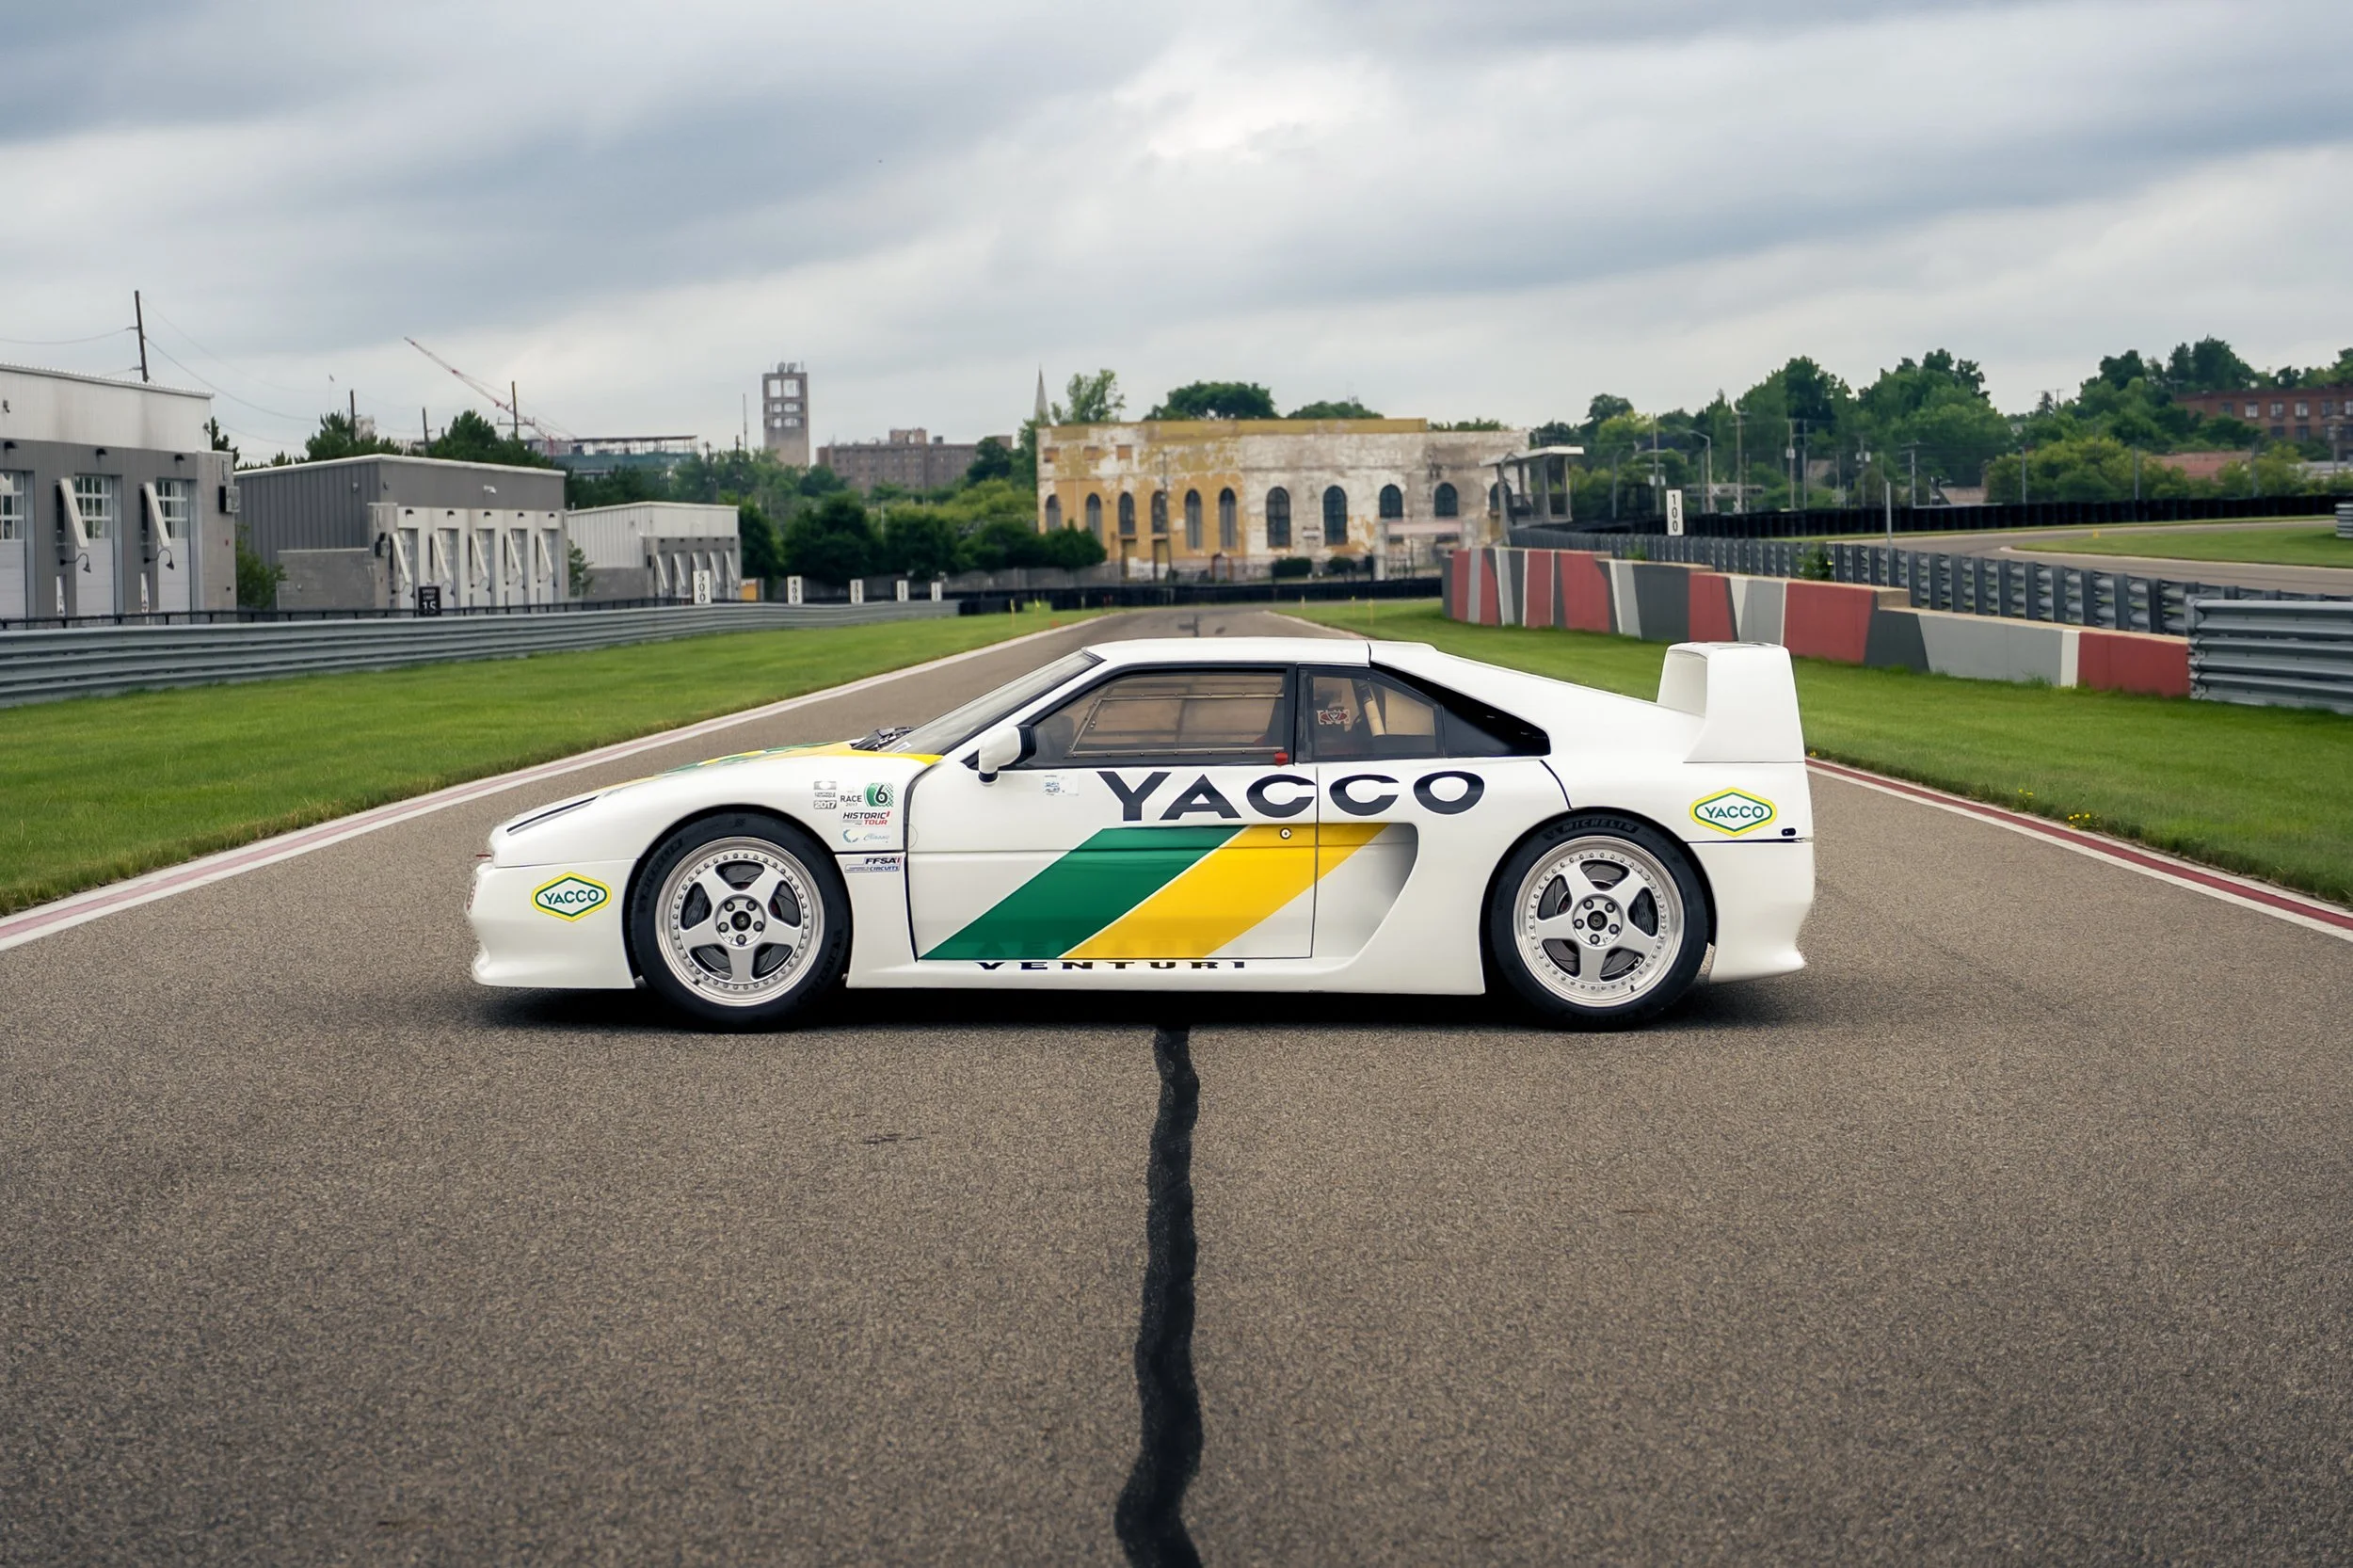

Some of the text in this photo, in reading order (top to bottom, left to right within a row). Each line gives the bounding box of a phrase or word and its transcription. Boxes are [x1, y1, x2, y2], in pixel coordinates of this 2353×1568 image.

[875, 784, 888, 804] 6
[1096, 770, 1485, 822] YACCO
[1705, 805, 1764, 819] YACCO
[1562, 818, 1635, 833] MICHELIN
[544, 888, 599, 904] YACCO
[974, 961, 1245, 970] VENTURI
